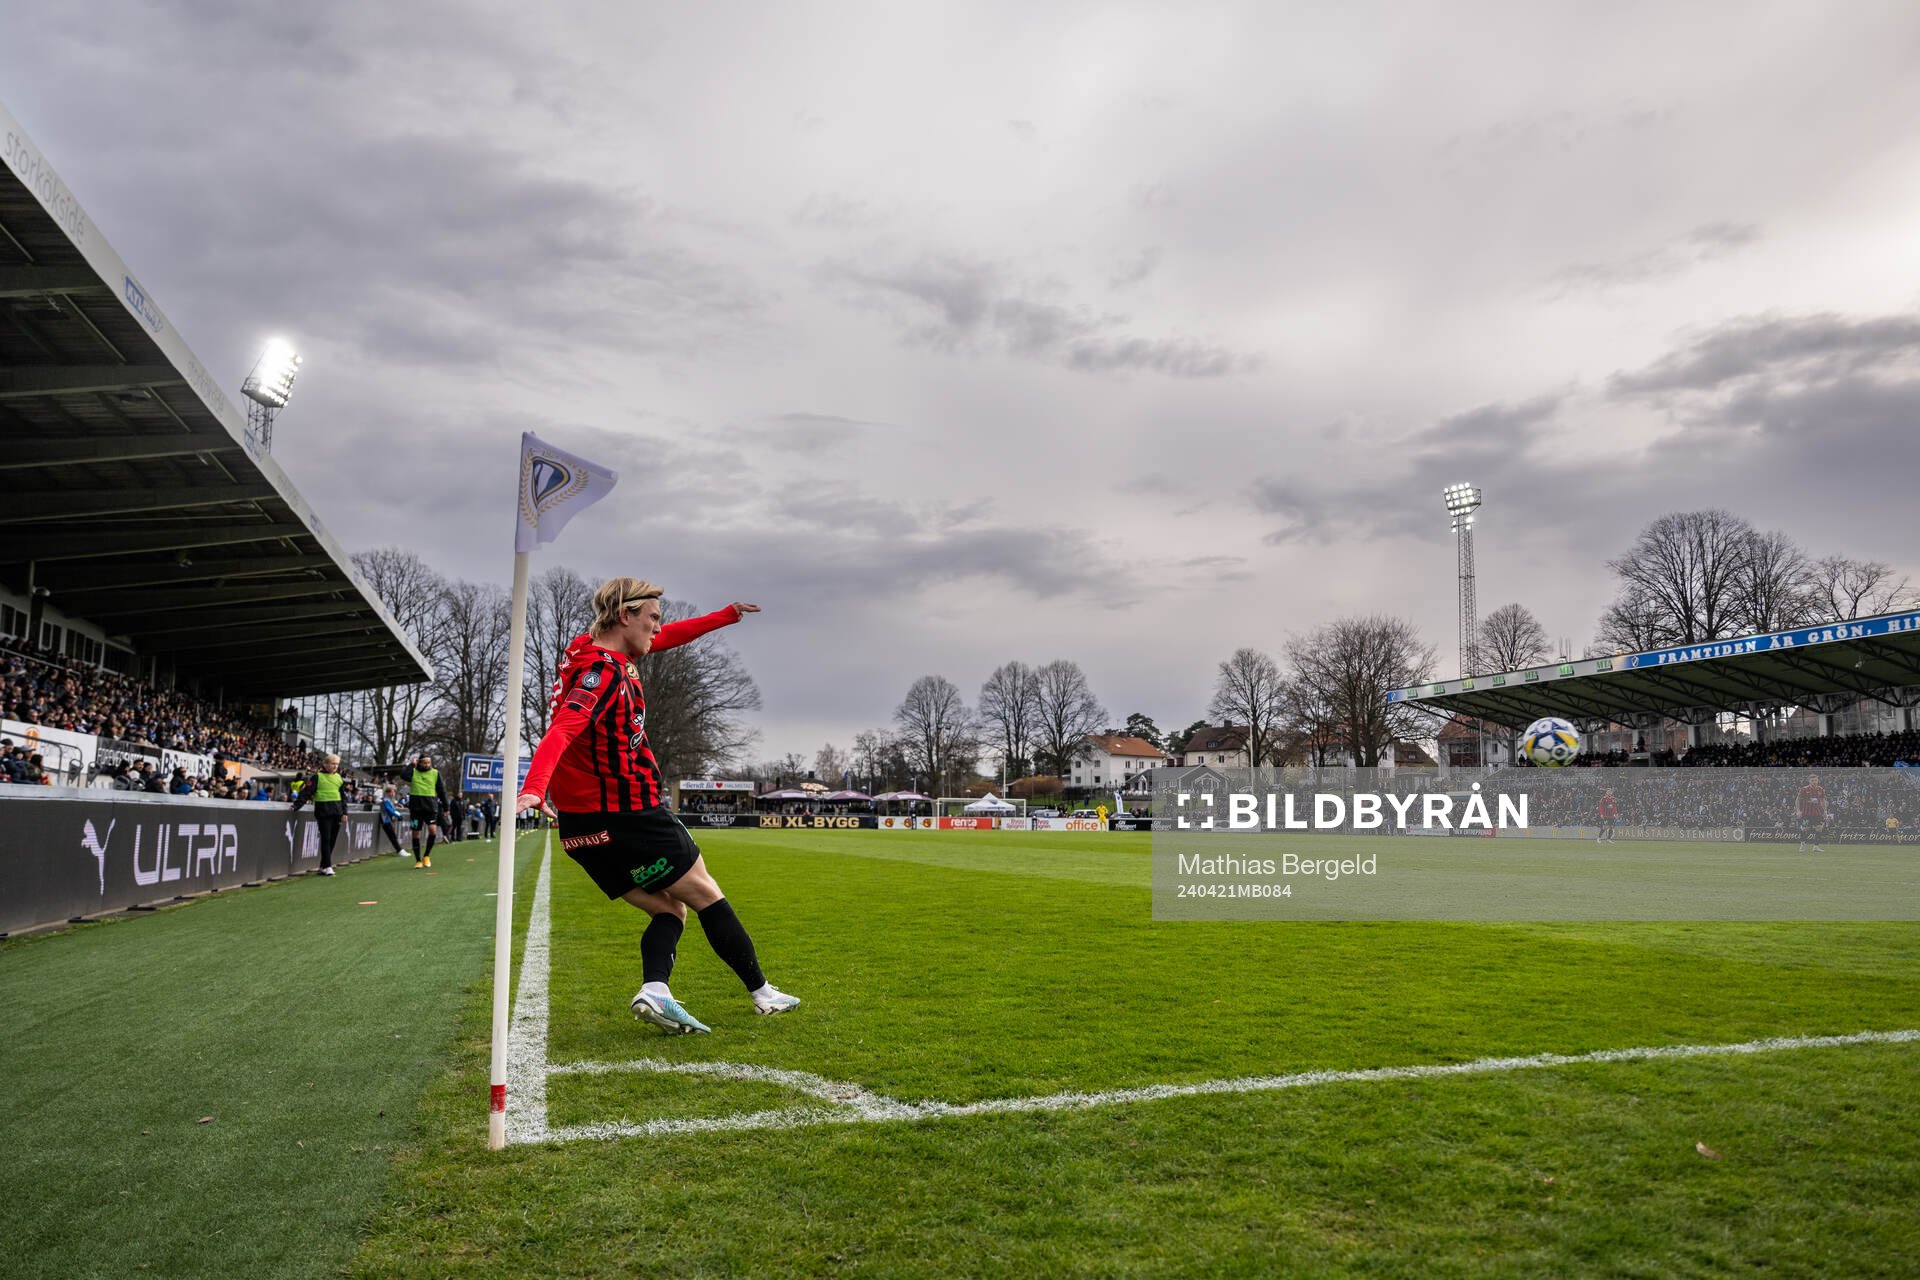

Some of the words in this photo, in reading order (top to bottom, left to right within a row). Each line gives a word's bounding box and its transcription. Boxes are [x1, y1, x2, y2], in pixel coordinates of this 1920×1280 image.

[1658, 641, 1756, 664] FRAMTIDEN
[1769, 635, 1794, 649] ÄR
[1808, 624, 1872, 643] GRÖN,
[471, 763, 489, 777] NP
[762, 817, 779, 826] XL
[786, 816, 859, 828] XL-BYGG
[1065, 819, 1098, 831] office
[1618, 829, 1675, 838] HALMSTADS
[1680, 829, 1728, 839] STENHUS
[1749, 829, 1773, 843] fritz
[1839, 830, 1867, 844] fritz
[134, 823, 238, 886] ULTRA
